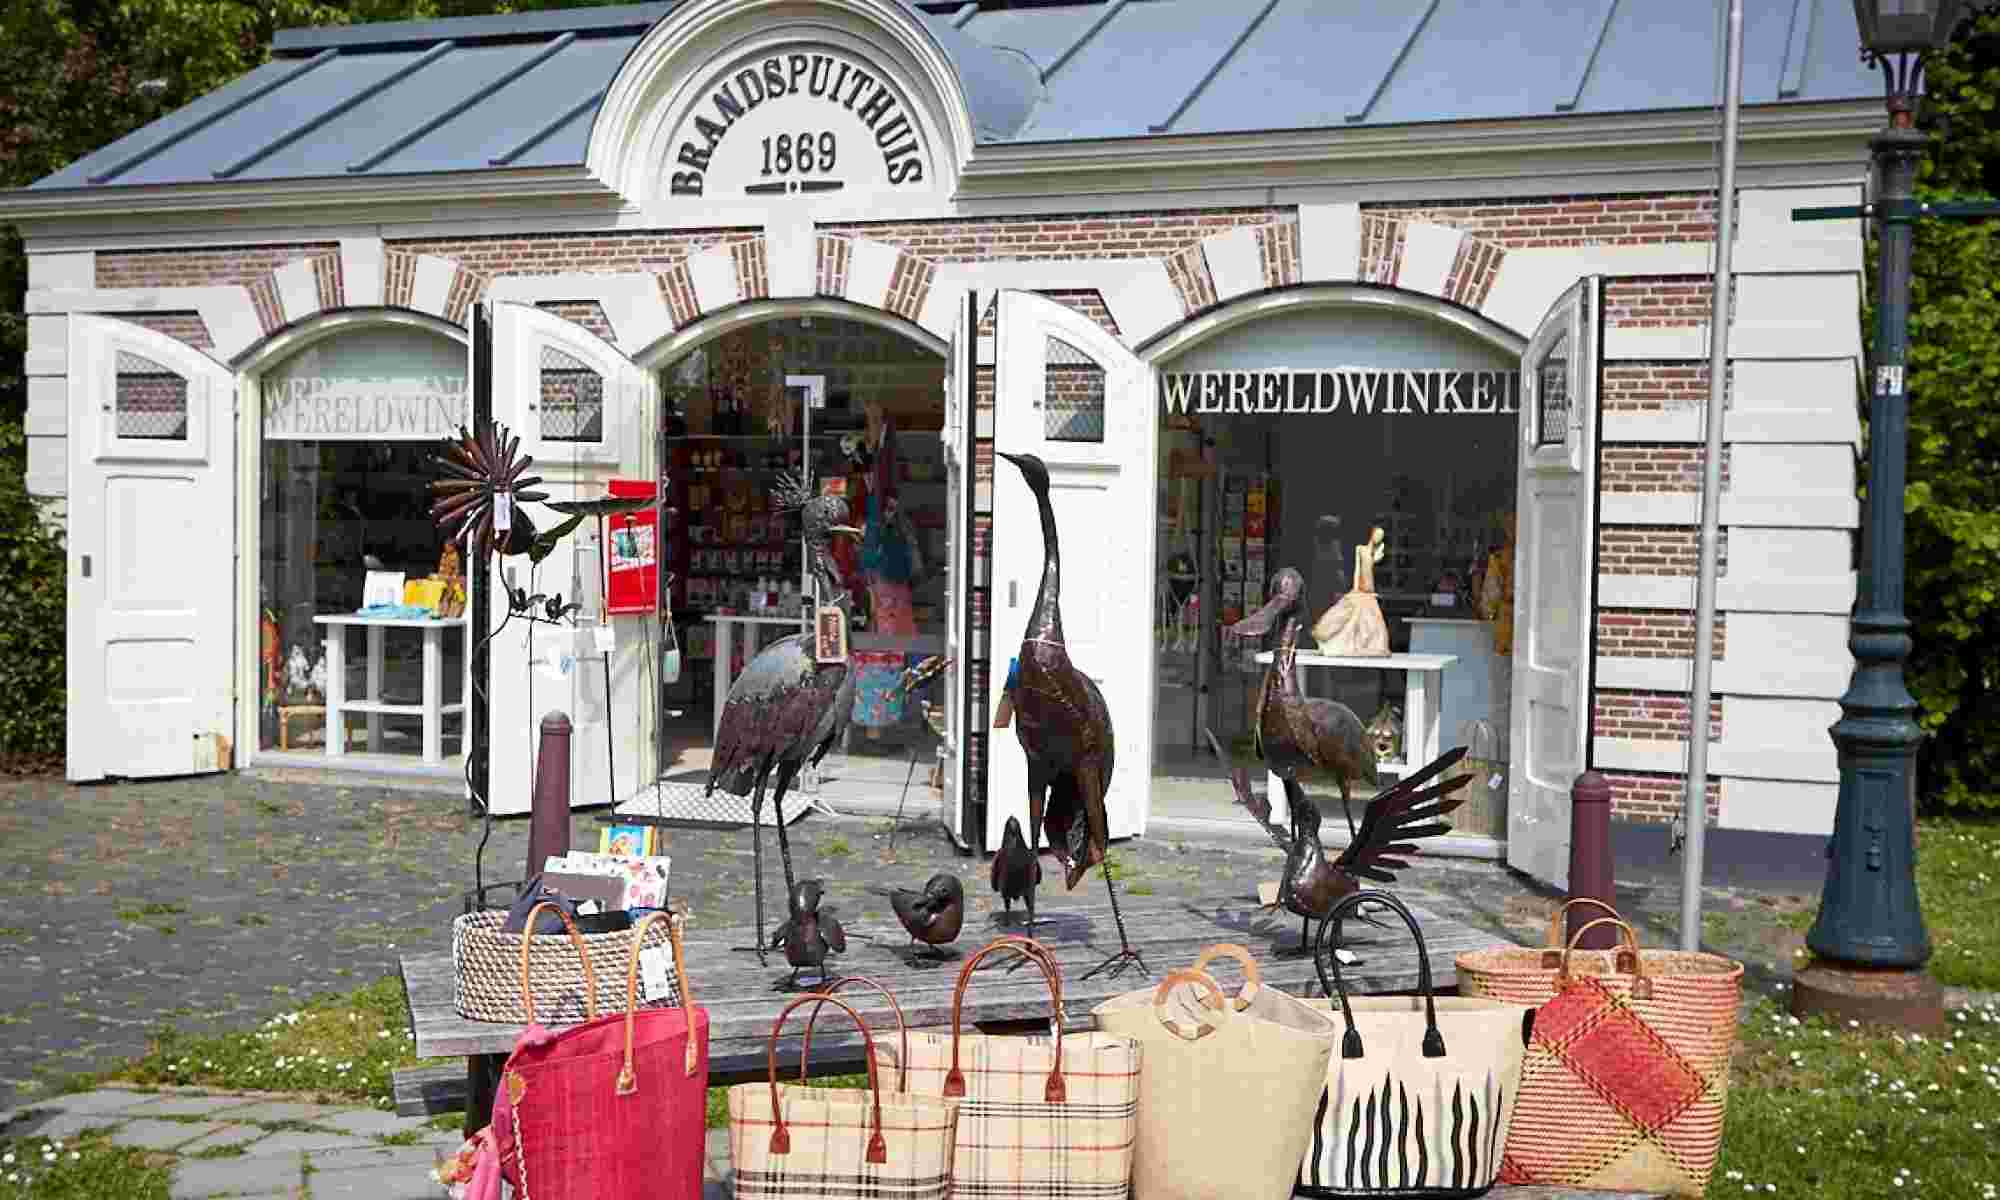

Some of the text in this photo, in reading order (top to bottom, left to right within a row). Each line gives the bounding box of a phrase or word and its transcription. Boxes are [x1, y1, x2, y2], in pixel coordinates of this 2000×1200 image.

[671, 54, 923, 197] BRANDSPUITHUIS
[760, 131, 836, 176] 1869
[264, 377, 472, 434] WERELDWIN
